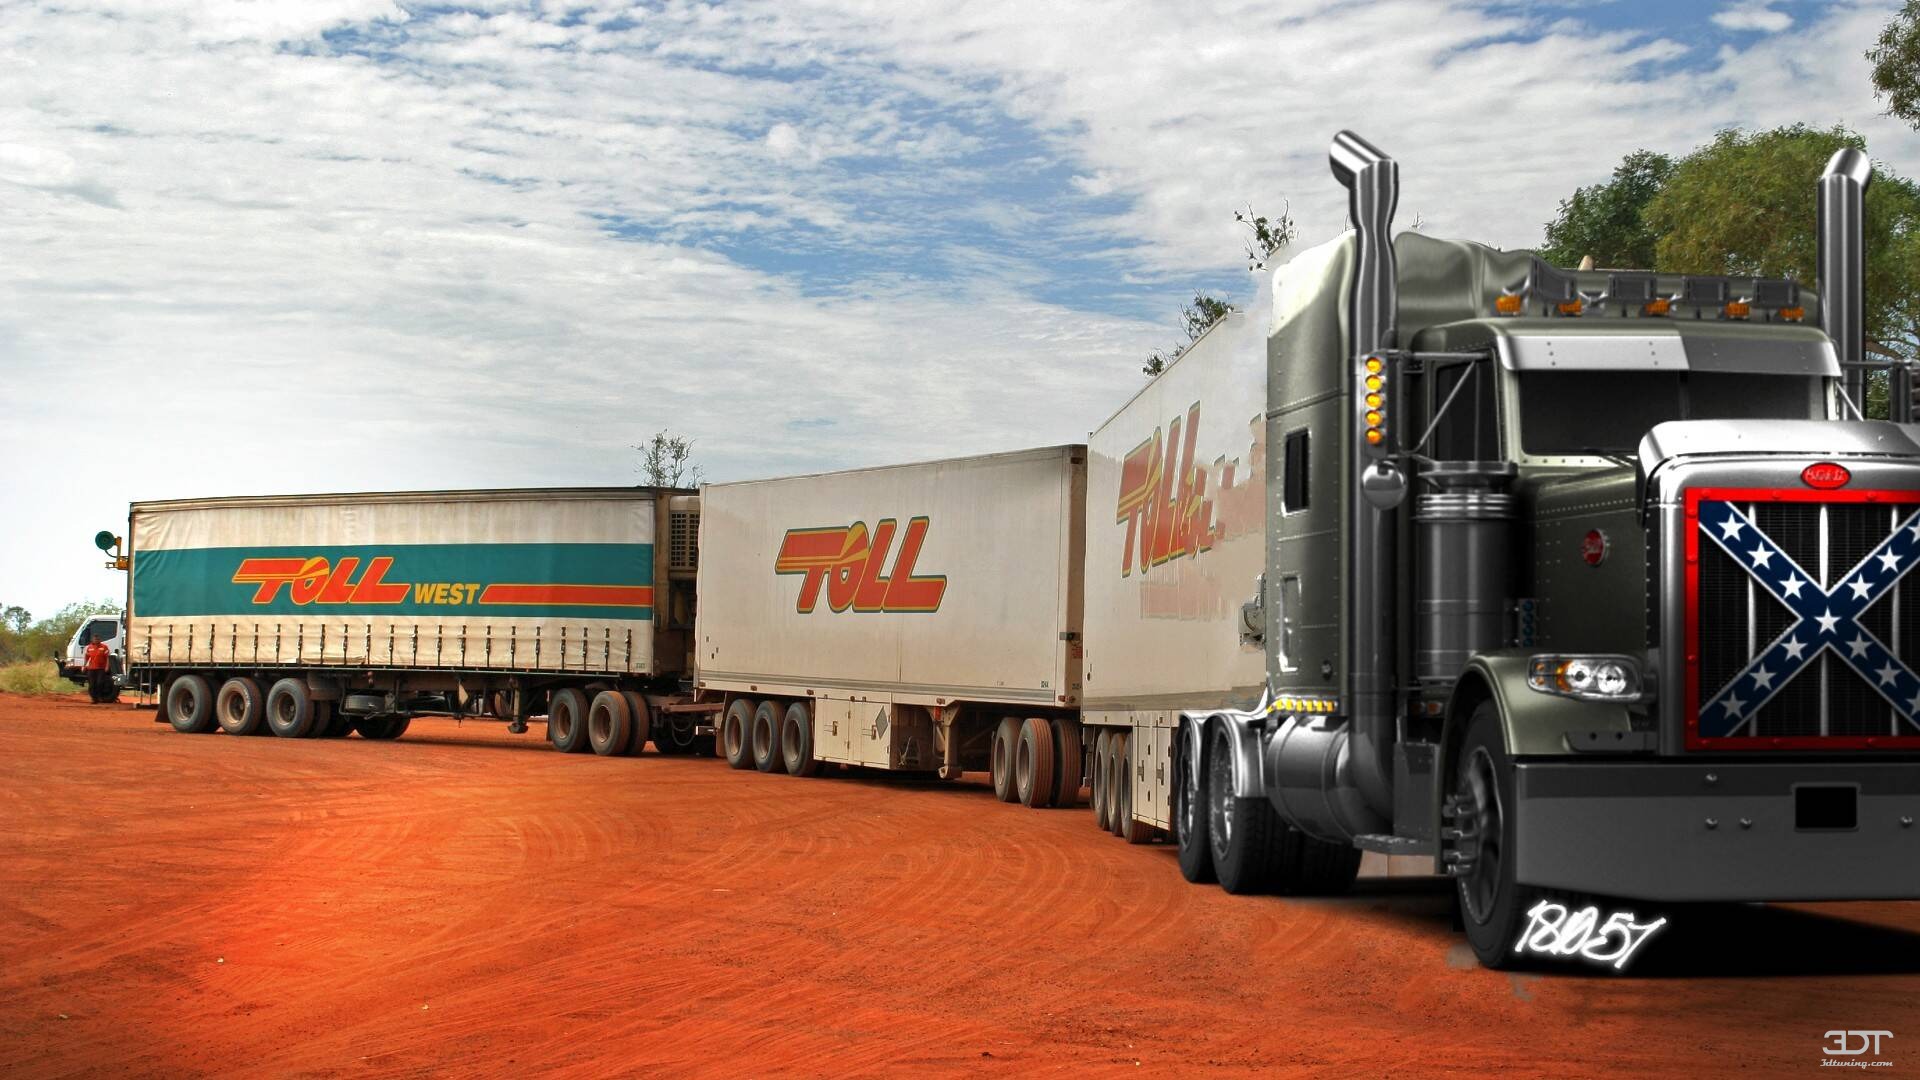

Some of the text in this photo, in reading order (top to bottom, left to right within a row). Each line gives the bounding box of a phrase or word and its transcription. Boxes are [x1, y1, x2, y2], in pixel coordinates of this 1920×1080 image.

[232, 557, 480, 605] TOLL WEST
[775, 516, 947, 613] TOLL
